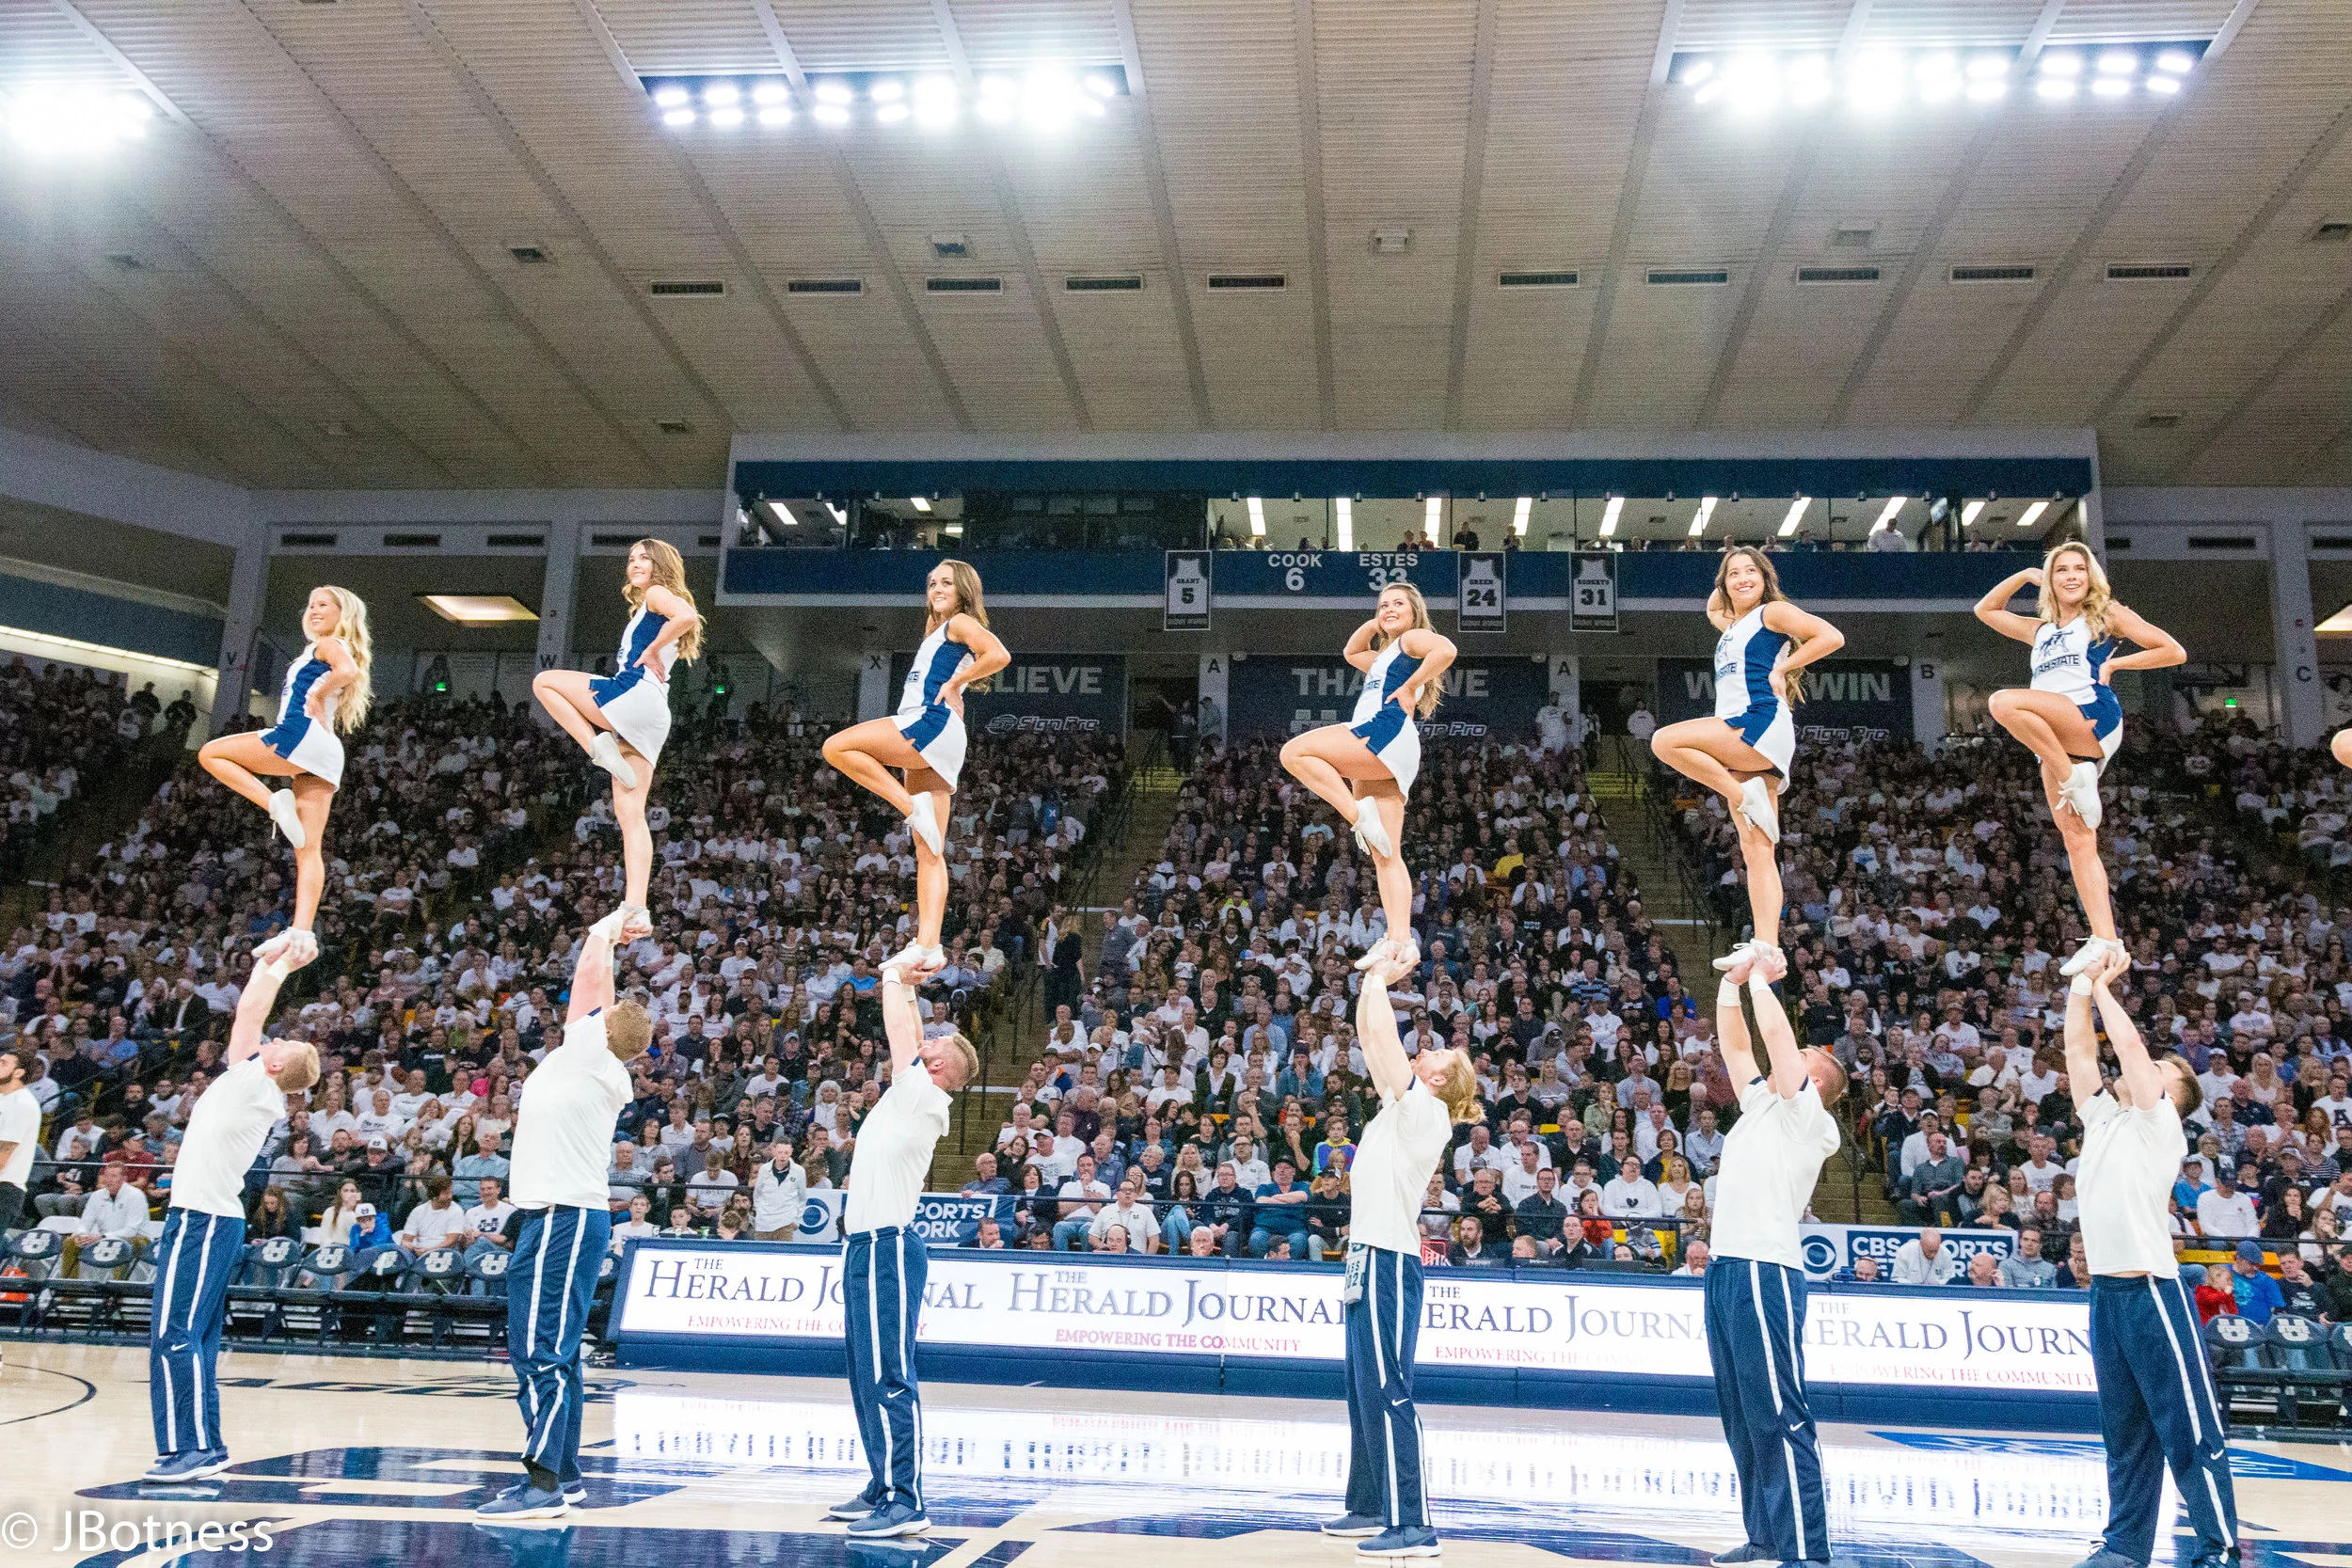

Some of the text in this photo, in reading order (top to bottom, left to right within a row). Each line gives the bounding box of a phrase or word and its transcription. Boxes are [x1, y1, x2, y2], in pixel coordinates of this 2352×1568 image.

[1268, 553, 1323, 567] COOK
[1359, 553, 1418, 567] ESTES
[1285, 567, 1305, 591] 6
[1368, 567, 1408, 591] 33
[1182, 587, 1194, 604] 5
[1467, 588, 1497, 607] 24
[1581, 588, 1608, 606] 31
[540, 654, 558, 668] W
[869, 656, 882, 671] X
[1207, 658, 1221, 673] A
[1557, 660, 1572, 676] A
[1920, 664, 1934, 679] B
[2296, 666, 2312, 682] C
[991, 667, 1102, 694] LIEVE
[1292, 669, 1364, 696] THA
[1806, 673, 1891, 701] WIN
[1418, 721, 1486, 736] ign Pro
[914, 1201, 987, 1220] PORTS
[1851, 1236, 2009, 1260] CBS ORTS
[694, 1258, 724, 1270] THE
[644, 1259, 804, 1303] HERALD
[1056, 1271, 1088, 1284] THE
[1008, 1272, 1173, 1318] HERALD
[1429, 1286, 1461, 1299] THE
[1818, 1302, 1851, 1314] THE
[688, 1315, 790, 1331] EMPOWERING
[795, 1317, 824, 1332] THE
[1422, 1294, 1708, 1344] ERALD JOURN
[1056, 1329, 1301, 1353] EMPOWERING THE COMMUNITY
[1958, 1310, 2092, 1360] JOURN
[1436, 1346, 1545, 1364] EMPOWERING
[1551, 1352, 1578, 1365] THE
[1950, 1369, 1980, 1382] THE
[1985, 1370, 2092, 1386] COMMUNITY
